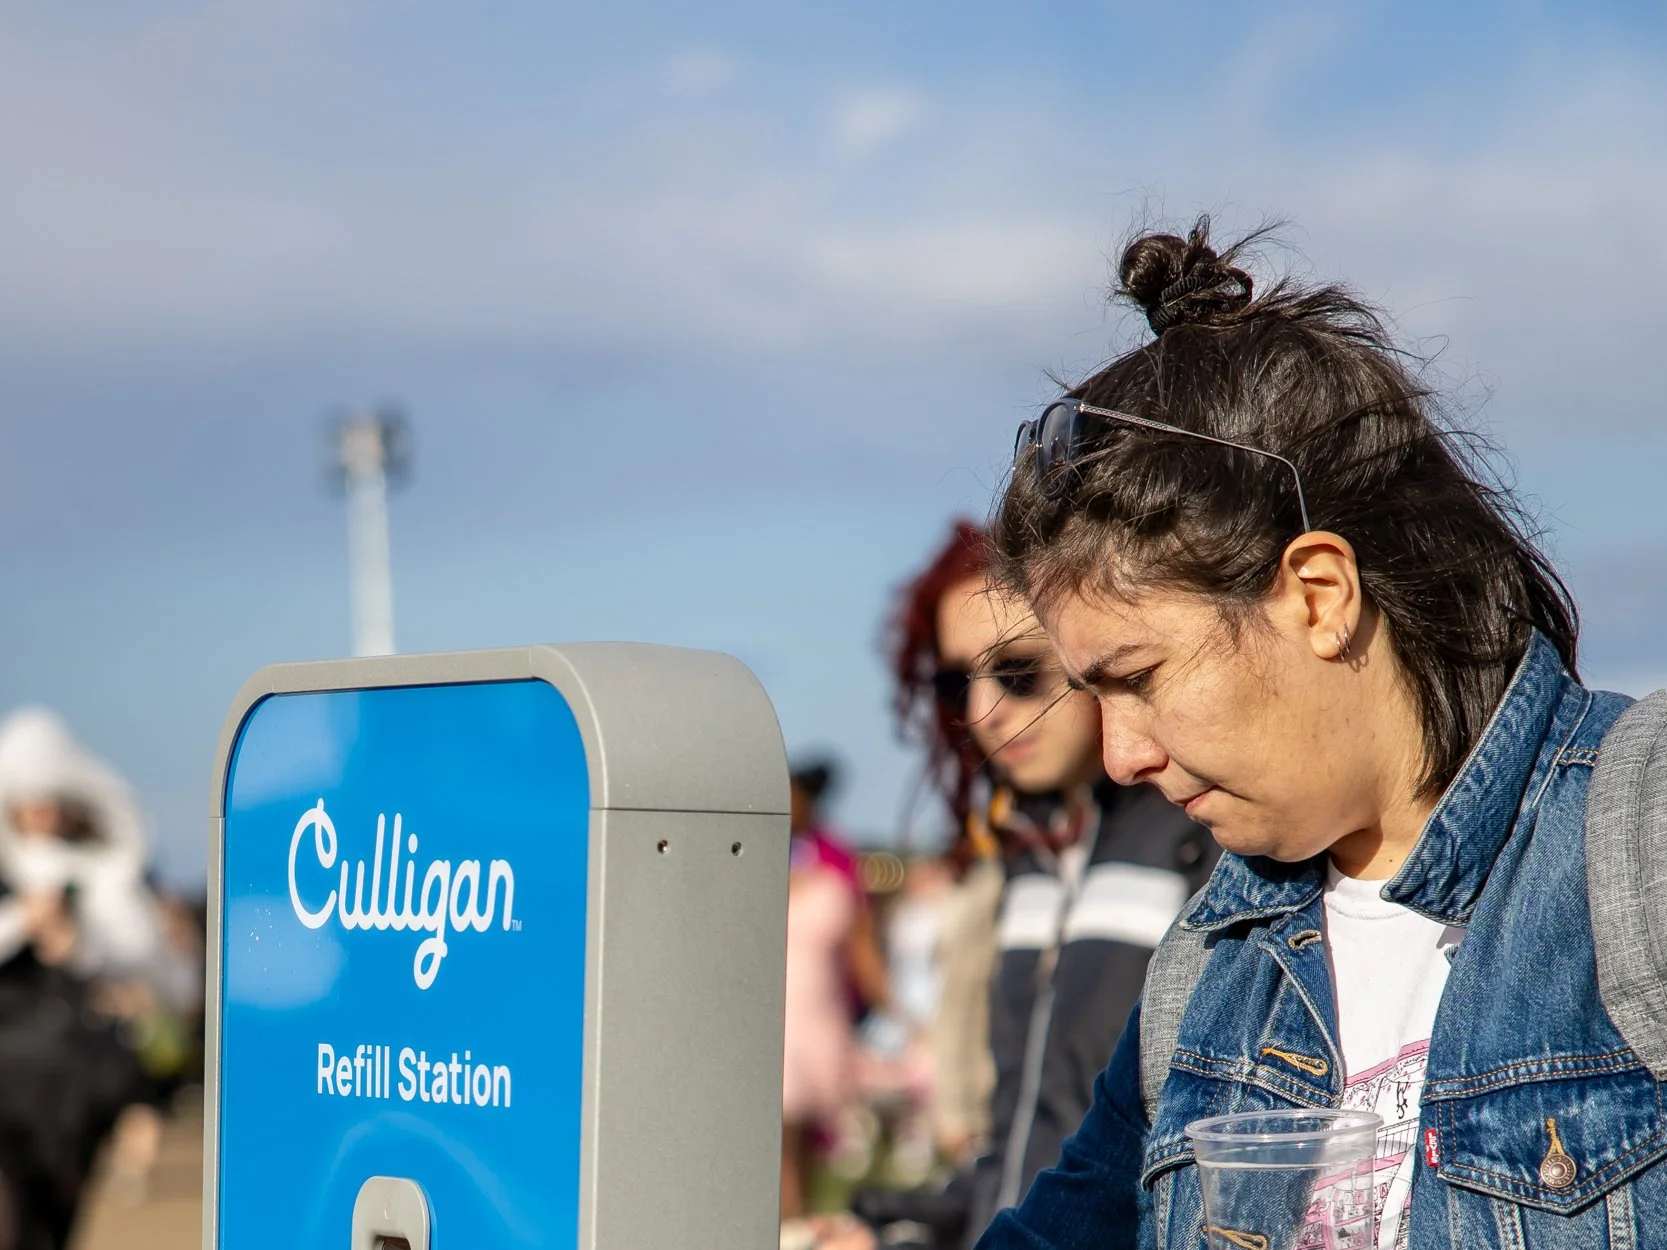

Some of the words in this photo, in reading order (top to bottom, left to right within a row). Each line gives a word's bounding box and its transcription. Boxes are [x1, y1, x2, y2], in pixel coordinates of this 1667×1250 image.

[288, 798, 514, 989] Culligan
[317, 1043, 390, 1098] Refill
[398, 1047, 511, 1107] Station
